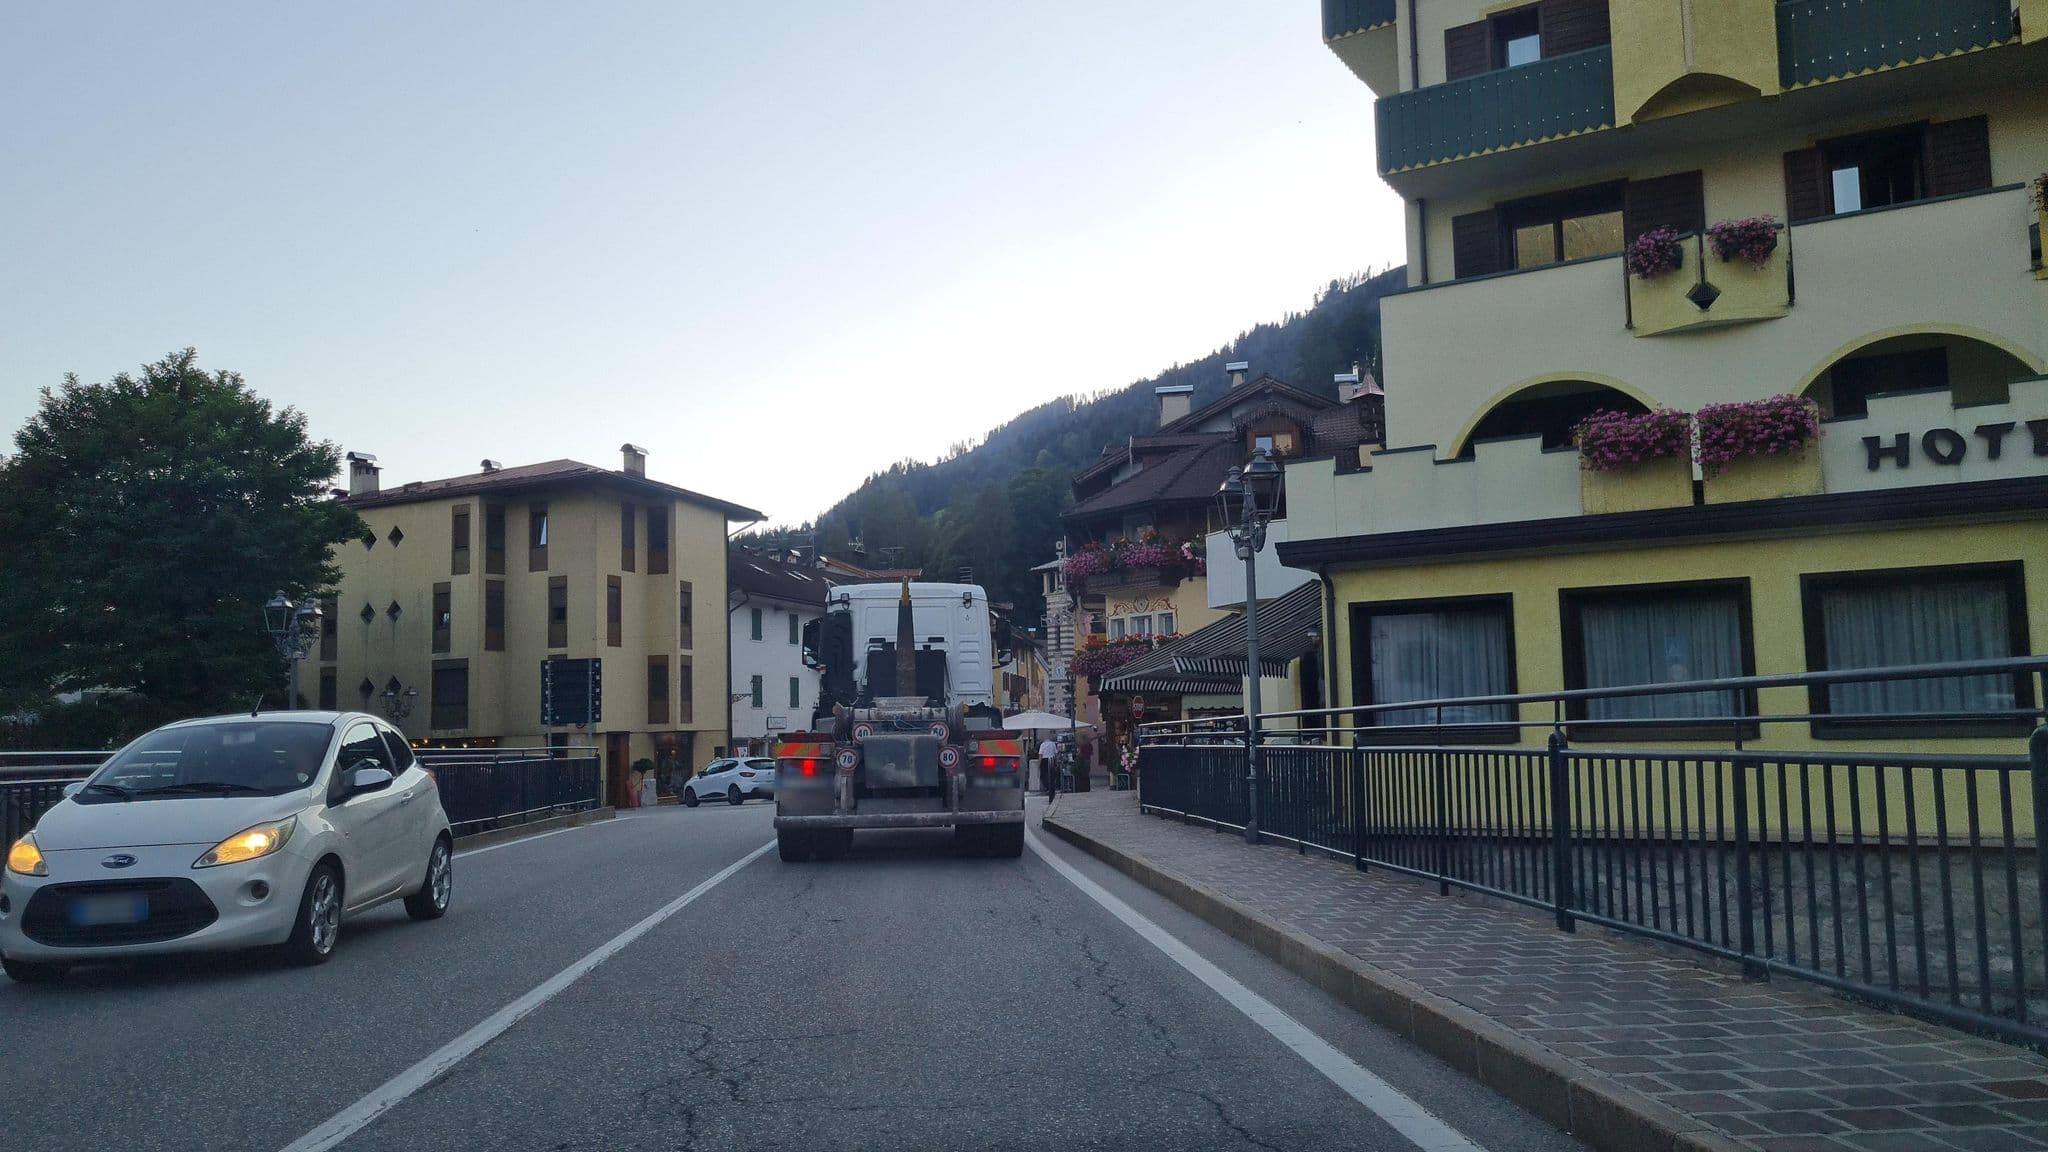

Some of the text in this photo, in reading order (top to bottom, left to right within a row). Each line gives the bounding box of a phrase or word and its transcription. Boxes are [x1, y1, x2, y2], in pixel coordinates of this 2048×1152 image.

[857, 728, 869, 738] 40
[842, 754, 853, 764] 70
[942, 752, 954, 762] 80
